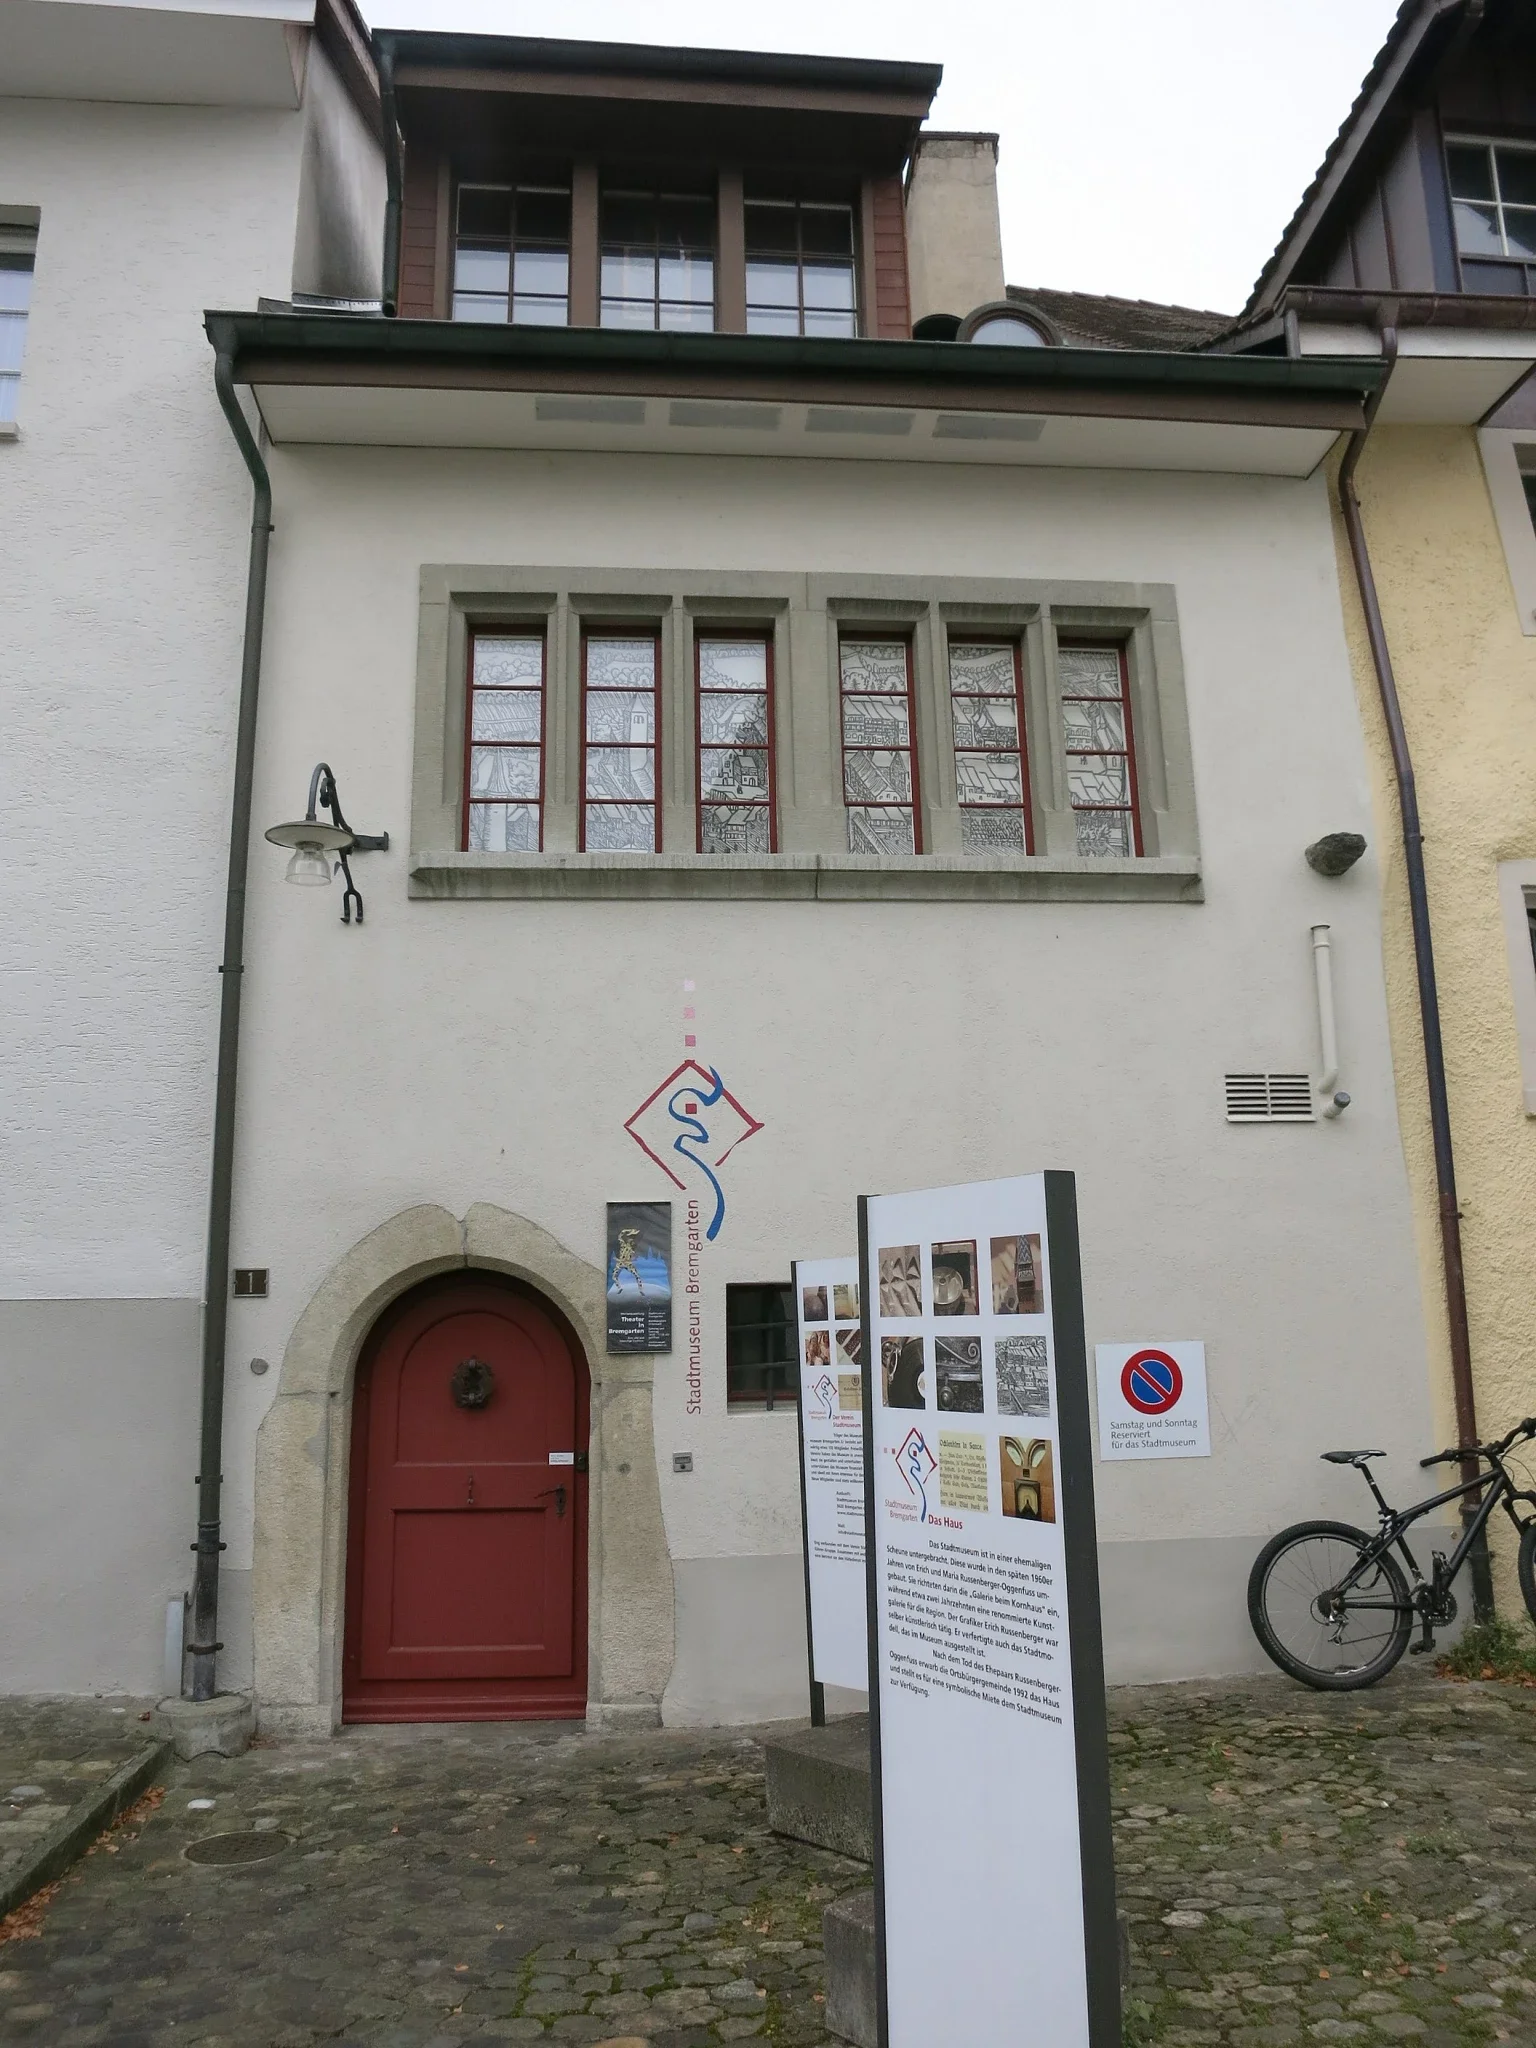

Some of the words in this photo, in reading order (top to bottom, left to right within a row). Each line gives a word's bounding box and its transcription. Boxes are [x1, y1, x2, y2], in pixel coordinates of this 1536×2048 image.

[685, 1200, 703, 1294] Bremgarten
[247, 1272, 253, 1293] 1
[686, 1300, 701, 1414] Stadtmuseum
[1110, 1421, 1144, 1430] Samstag
[1146, 1419, 1162, 1428] und
[1165, 1418, 1198, 1429] Sonntag
[1111, 1430, 1151, 1439] Reserviert
[1111, 1441, 1123, 1449] für
[1125, 1439, 1140, 1448] das
[1141, 1439, 1197, 1448] Stadtmuseum
[885, 1499, 918, 1511] Stadtmuseum
[890, 1510, 918, 1522] Bremgarten
[928, 1514, 942, 1526] Das
[944, 1518, 963, 1529] Haus
[887, 1545, 908, 1556] Scheune
[909, 1551, 948, 1565] untergebracht.
[951, 1558, 965, 1569] Diese
[967, 1562, 986, 1573] wurde
[988, 1565, 993, 1574] in
[995, 1567, 1006, 1577] den
[1008, 1570, 1029, 1580] späten
[1032, 1574, 1053, 1586] 1960er
[928, 1540, 939, 1549] Das
[941, 1542, 979, 1557] Stadtmuseum
[990, 1551, 995, 1560] in
[997, 1553, 1012, 1563] einer
[1014, 1556, 1051, 1571] ehemaligen
[887, 1558, 904, 1569] Jahren
[905, 1563, 915, 1571] von
[916, 1564, 929, 1574] Erich
[931, 1569, 941, 1577] und
[943, 1570, 959, 1581] Maria
[1037, 1591, 1050, 1600] um-
[908, 1575, 916, 1584] Sie
[917, 1579, 941, 1591] richteten
[943, 1584, 957, 1594] darin
[959, 1588, 968, 1596] die
[995, 1595, 1010, 1605] beim
[1047, 1607, 1060, 1618] ein,
[888, 1585, 911, 1597] während
[912, 1591, 925, 1600] etwa
[926, 1595, 940, 1603] zwei
[941, 1597, 976, 1612] Jahrzehnten
[977, 1606, 990, 1616] eine
[991, 1610, 1032, 1626] renommierte
[1033, 1619, 1055, 1631] Kunst-
[888, 1599, 906, 1607] galerie
[907, 1602, 915, 1610] für
[916, 1604, 925, 1613] die
[926, 1607, 947, 1619] Region.
[948, 1612, 958, 1621] Der
[960, 1615, 983, 1627] Grafiker
[985, 1621, 999, 1632] Erich
[1001, 1625, 1044, 1644] Russenberger
[1045, 1638, 1059, 1647] war
[889, 1611, 904, 1621] selber
[905, 1614, 937, 1630] künstlerisch
[954, 1628, 961, 1636] Er
[962, 1631, 994, 1646] verfertigte
[995, 1639, 1010, 1650] auch
[1011, 1643, 1022, 1653] das
[1023, 1646, 1054, 1661] Stadtmo-
[889, 1624, 900, 1634] dell,
[901, 1627, 910, 1637] das
[911, 1630, 918, 1639] im
[919, 1632, 943, 1645] Museum
[944, 1640, 976, 1656] ausgestellt
[977, 1649, 986, 1658] ist.
[890, 1650, 918, 1666] Oggenfuss
[919, 1661, 939, 1672] erwarb
[940, 1666, 949, 1675] die
[950, 1668, 1012, 1694] Ortsbürgergemeinde
[1013, 1687, 1028, 1699] 1992
[1030, 1692, 1041, 1702] das
[1043, 1696, 1060, 1708] Haus
[890, 1678, 899, 1686] zur
[900, 1680, 930, 1697] Verfügung.
[932, 1649, 947, 1660] Nach
[948, 1654, 961, 1664] dem
[962, 1658, 973, 1667] Tod
[974, 1661, 984, 1671] des
[986, 1665, 1014, 1680] Ehepaars
[1015, 1673, 1061, 1693] Russenberger-
[890, 1665, 900, 1673] und
[901, 1668, 915, 1677] stellt
[923, 1674, 932, 1682] für
[933, 1677, 945, 1687] eine
[946, 1682, 981, 1698] symbolische
[982, 1692, 1000, 1705] Miete
[1001, 1698, 1016, 1709] dem
[1017, 1703, 1063, 1724] Stadtmuseum
